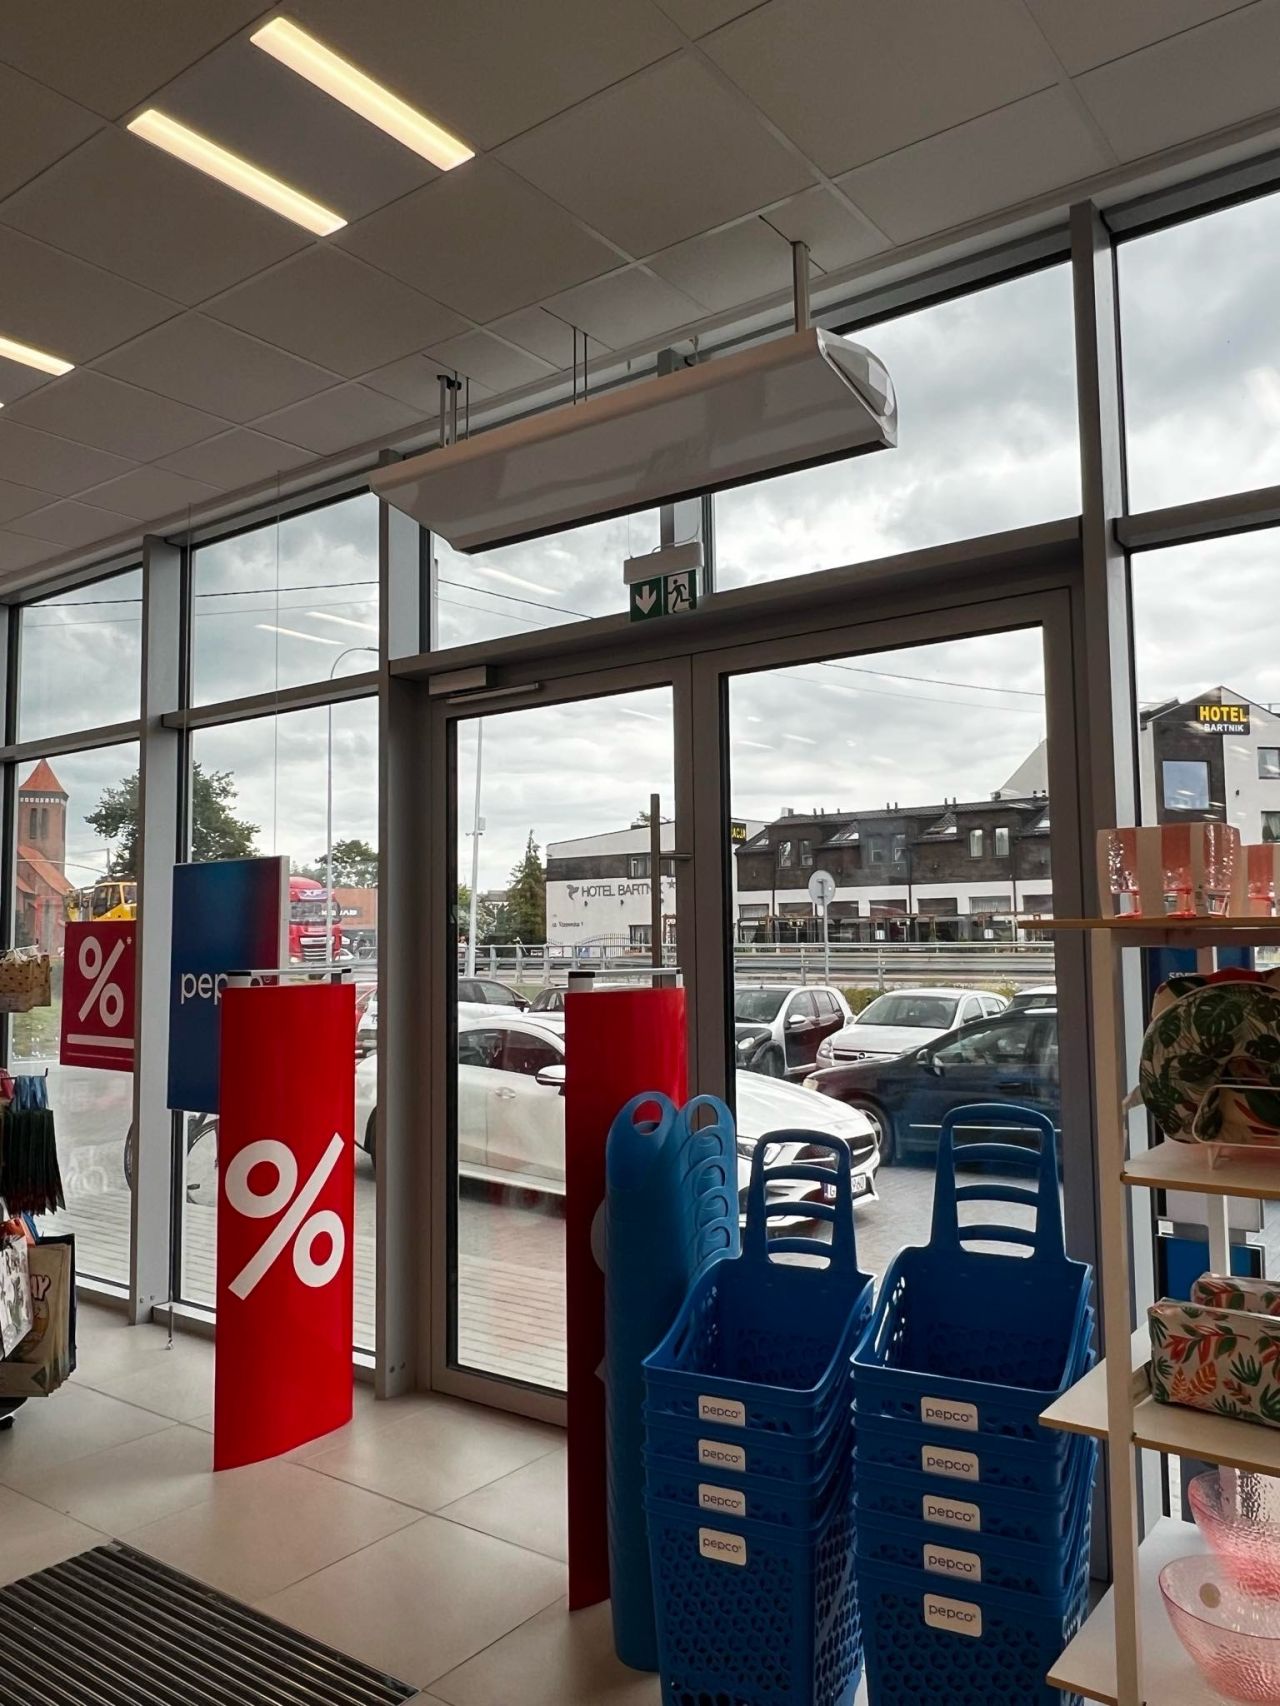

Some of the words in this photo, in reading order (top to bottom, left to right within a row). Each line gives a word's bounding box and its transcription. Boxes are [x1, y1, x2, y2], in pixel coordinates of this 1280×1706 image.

[1200, 706, 1247, 722] HOTEL
[1204, 723, 1244, 732] BARTNIK
[581, 885, 615, 897] HOTEL
[618, 882, 663, 896] BARTN
[180, 973, 264, 1006] pep
[702, 1405, 738, 1419] pepco
[925, 1407, 970, 1423] pepco
[702, 1448, 738, 1464] pepco
[926, 1456, 970, 1472] pepco
[702, 1493, 738, 1508] pepco
[927, 1505, 971, 1522] pepco
[702, 1537, 738, 1553] pepco
[928, 1555, 972, 1572] pepco
[928, 1604, 973, 1622] pepco
